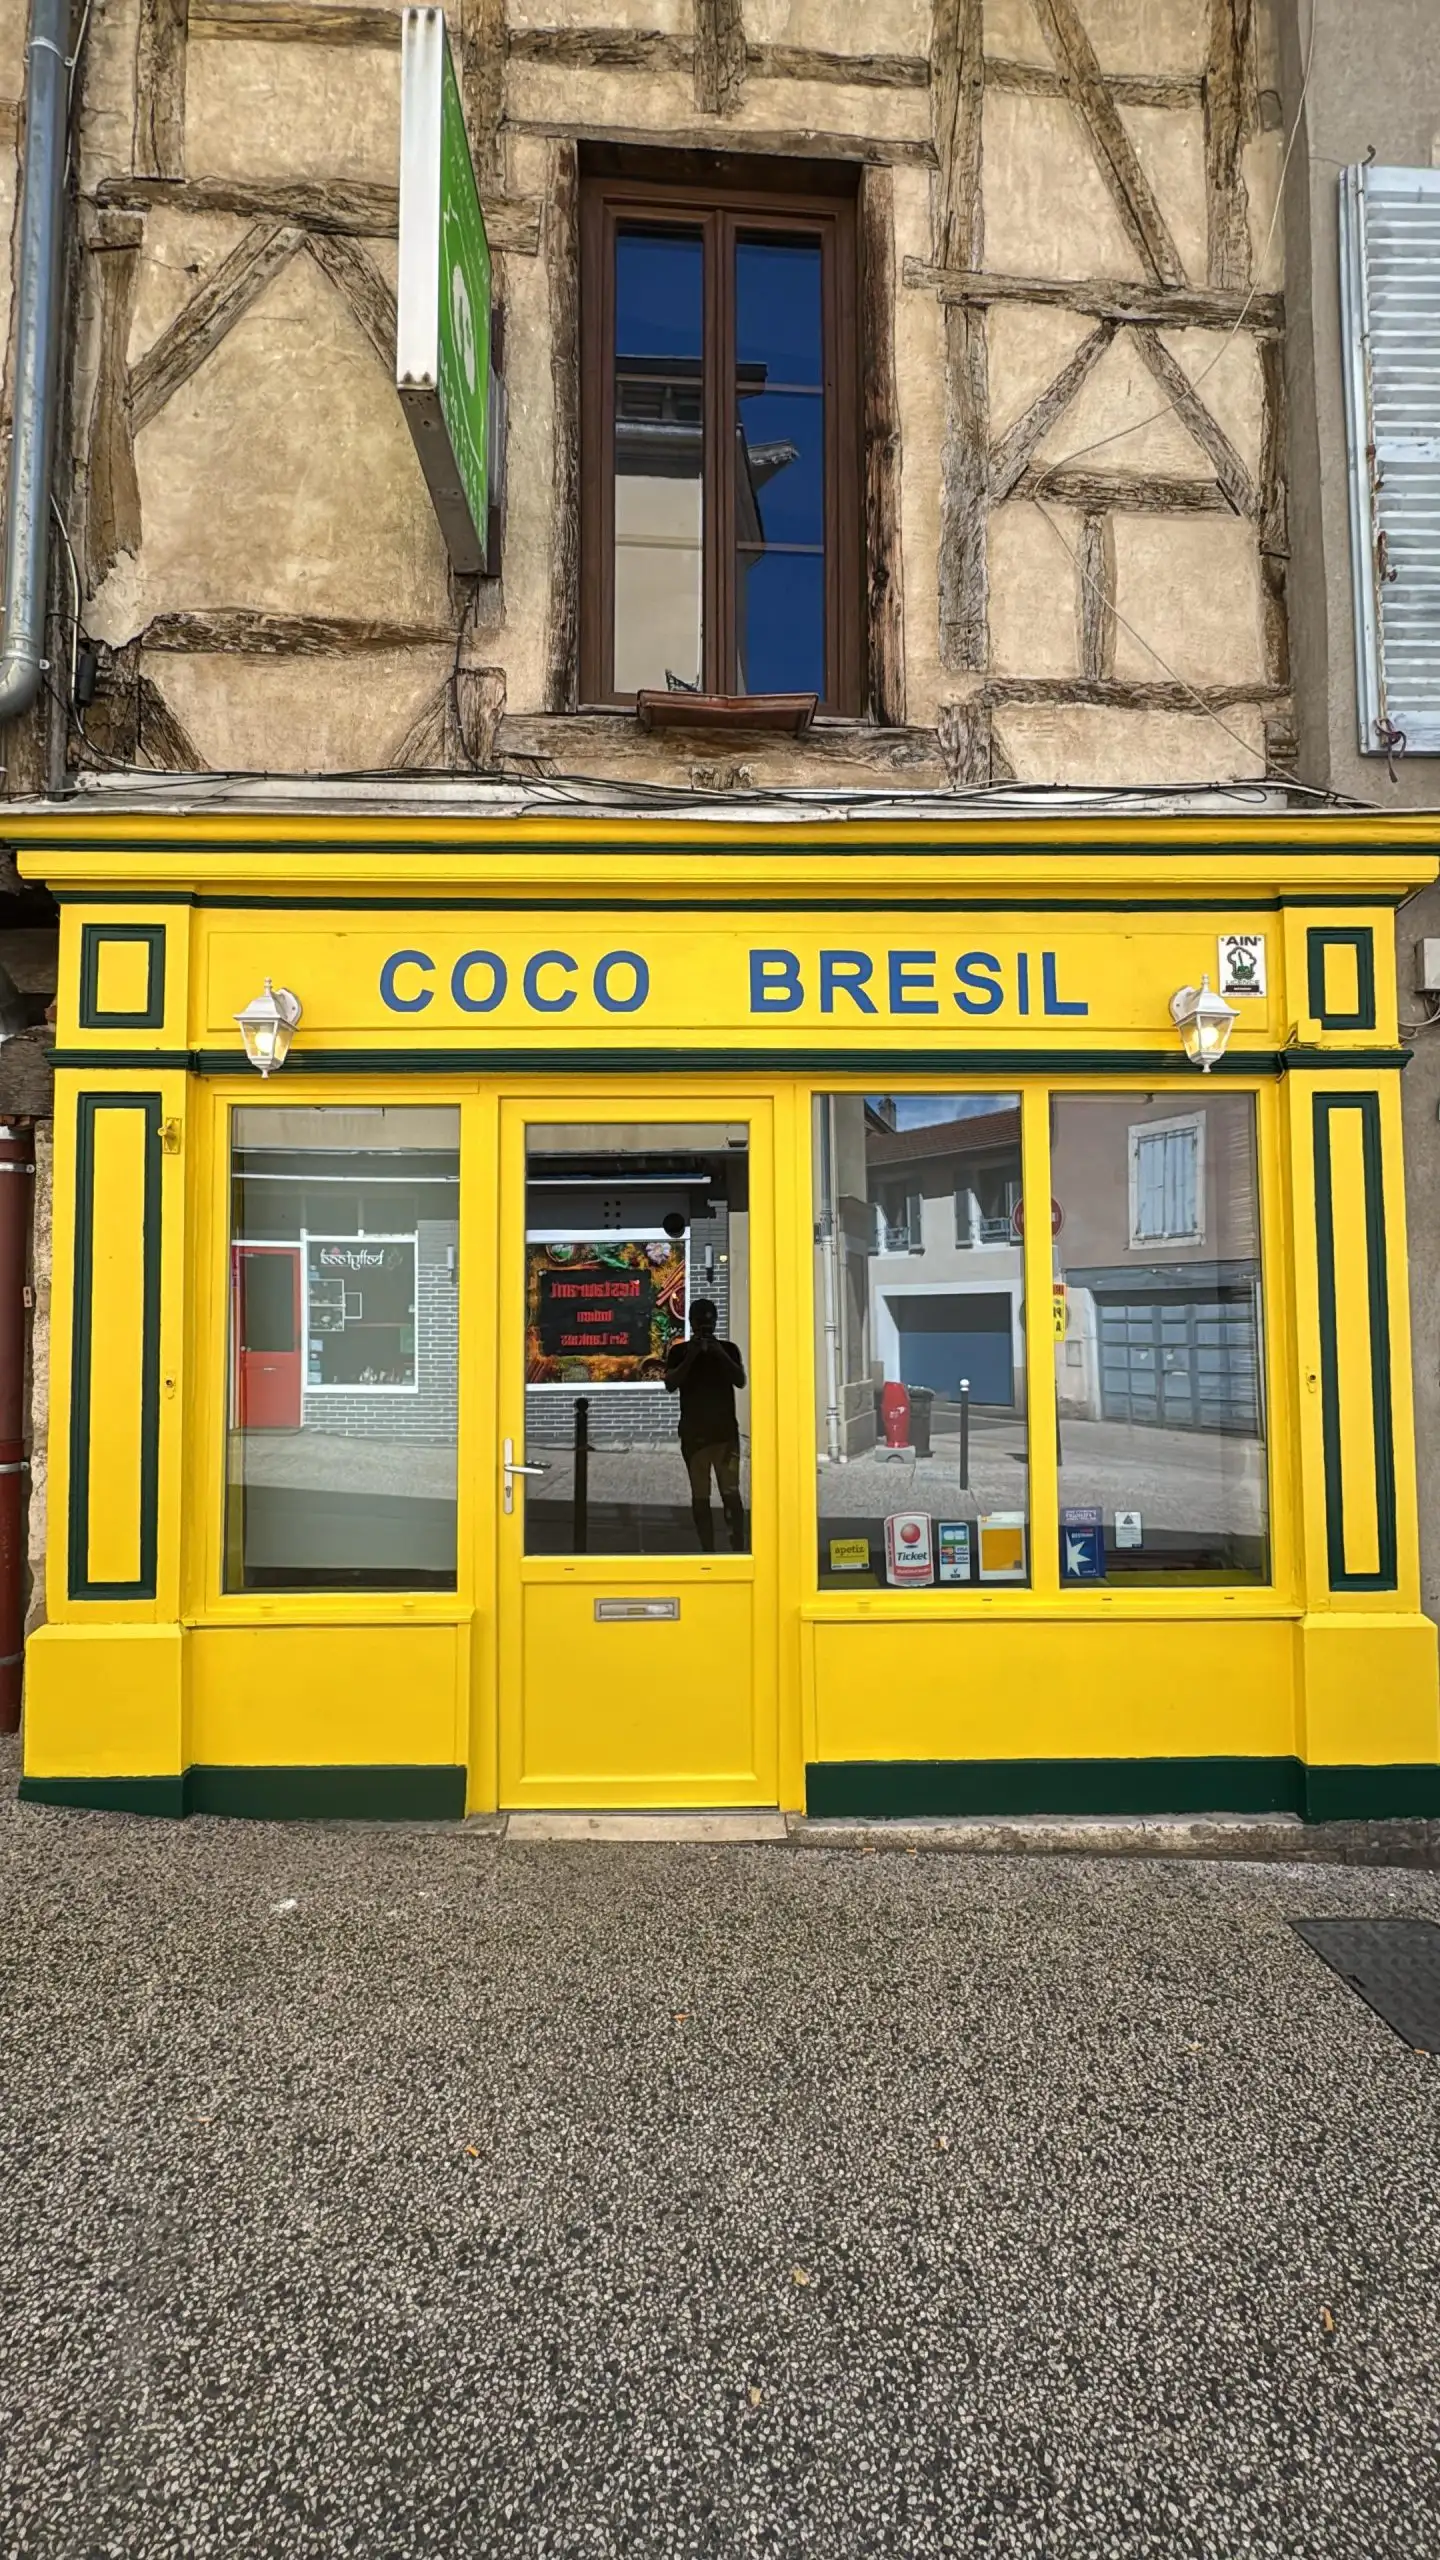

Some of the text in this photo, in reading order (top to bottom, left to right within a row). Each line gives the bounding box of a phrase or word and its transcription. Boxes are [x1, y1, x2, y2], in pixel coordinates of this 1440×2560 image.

[1225, 936, 1258, 946] AIN
[380, 949, 1090, 1017] COCO BRESIL
[896, 1551, 928, 1561] Ticket
